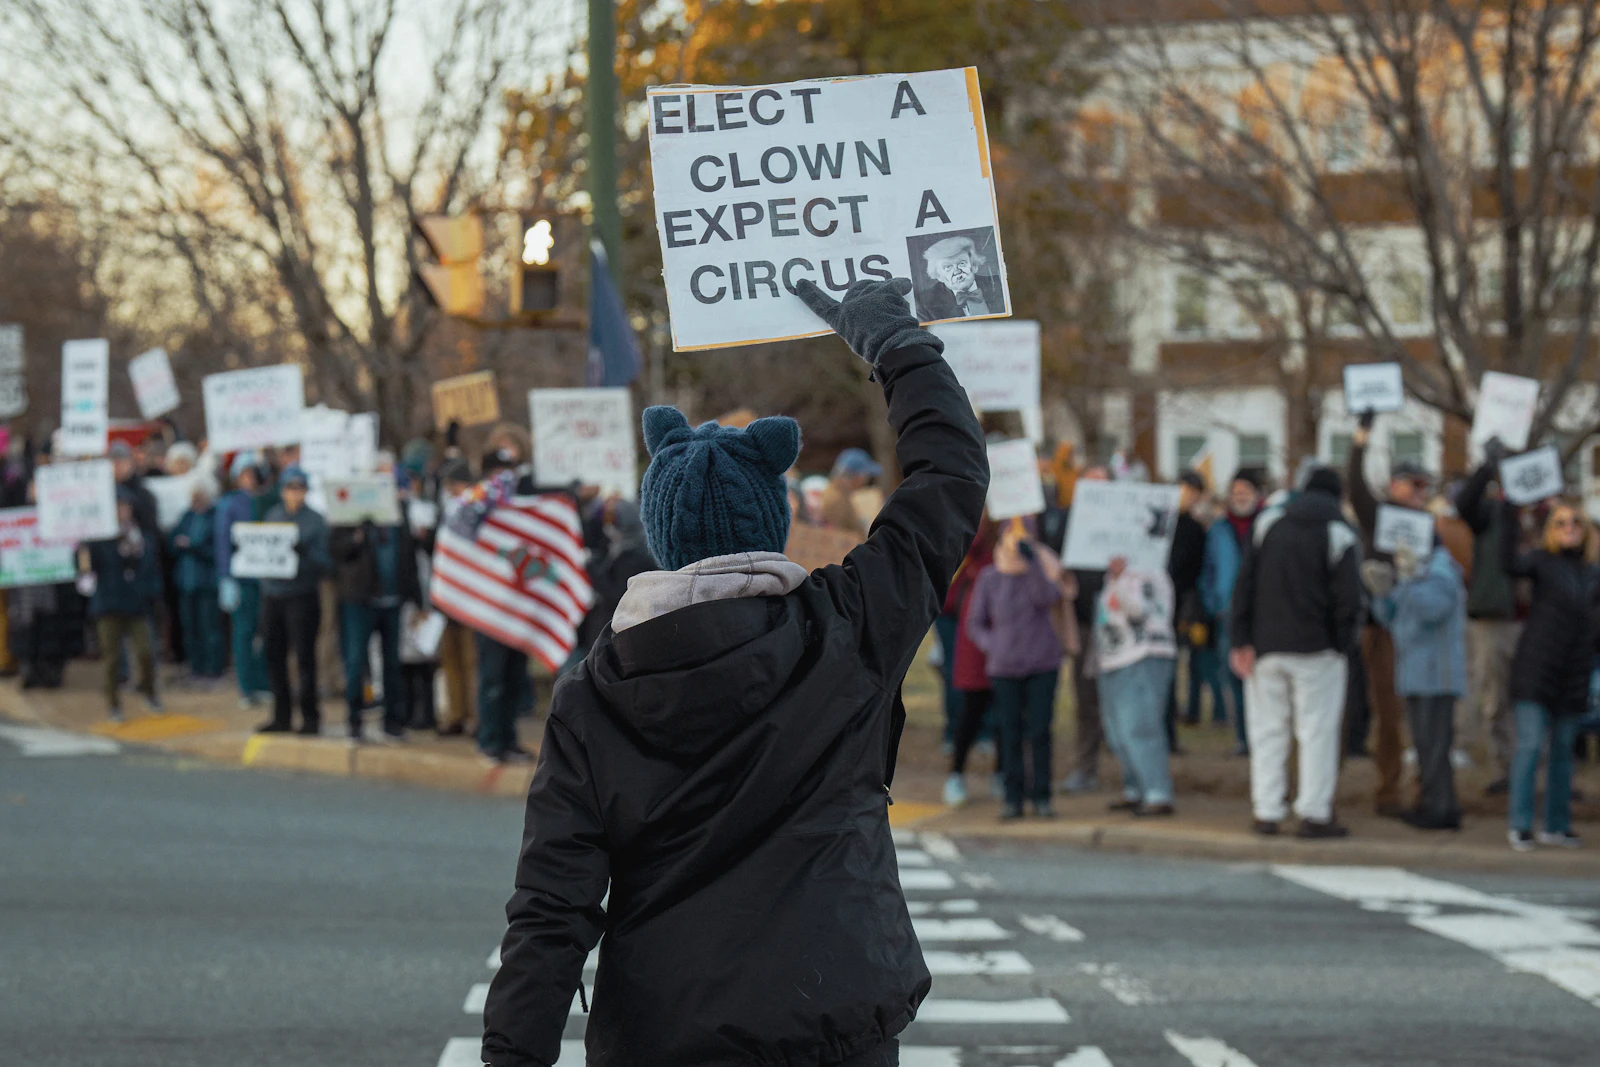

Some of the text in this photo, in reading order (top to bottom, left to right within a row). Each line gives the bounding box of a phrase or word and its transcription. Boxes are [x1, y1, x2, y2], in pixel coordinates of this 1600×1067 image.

[653, 80, 927, 134] ELECT A
[690, 138, 891, 193] CLOWN
[663, 189, 951, 248] EXPECT A
[690, 254, 893, 304] CIRCUS
